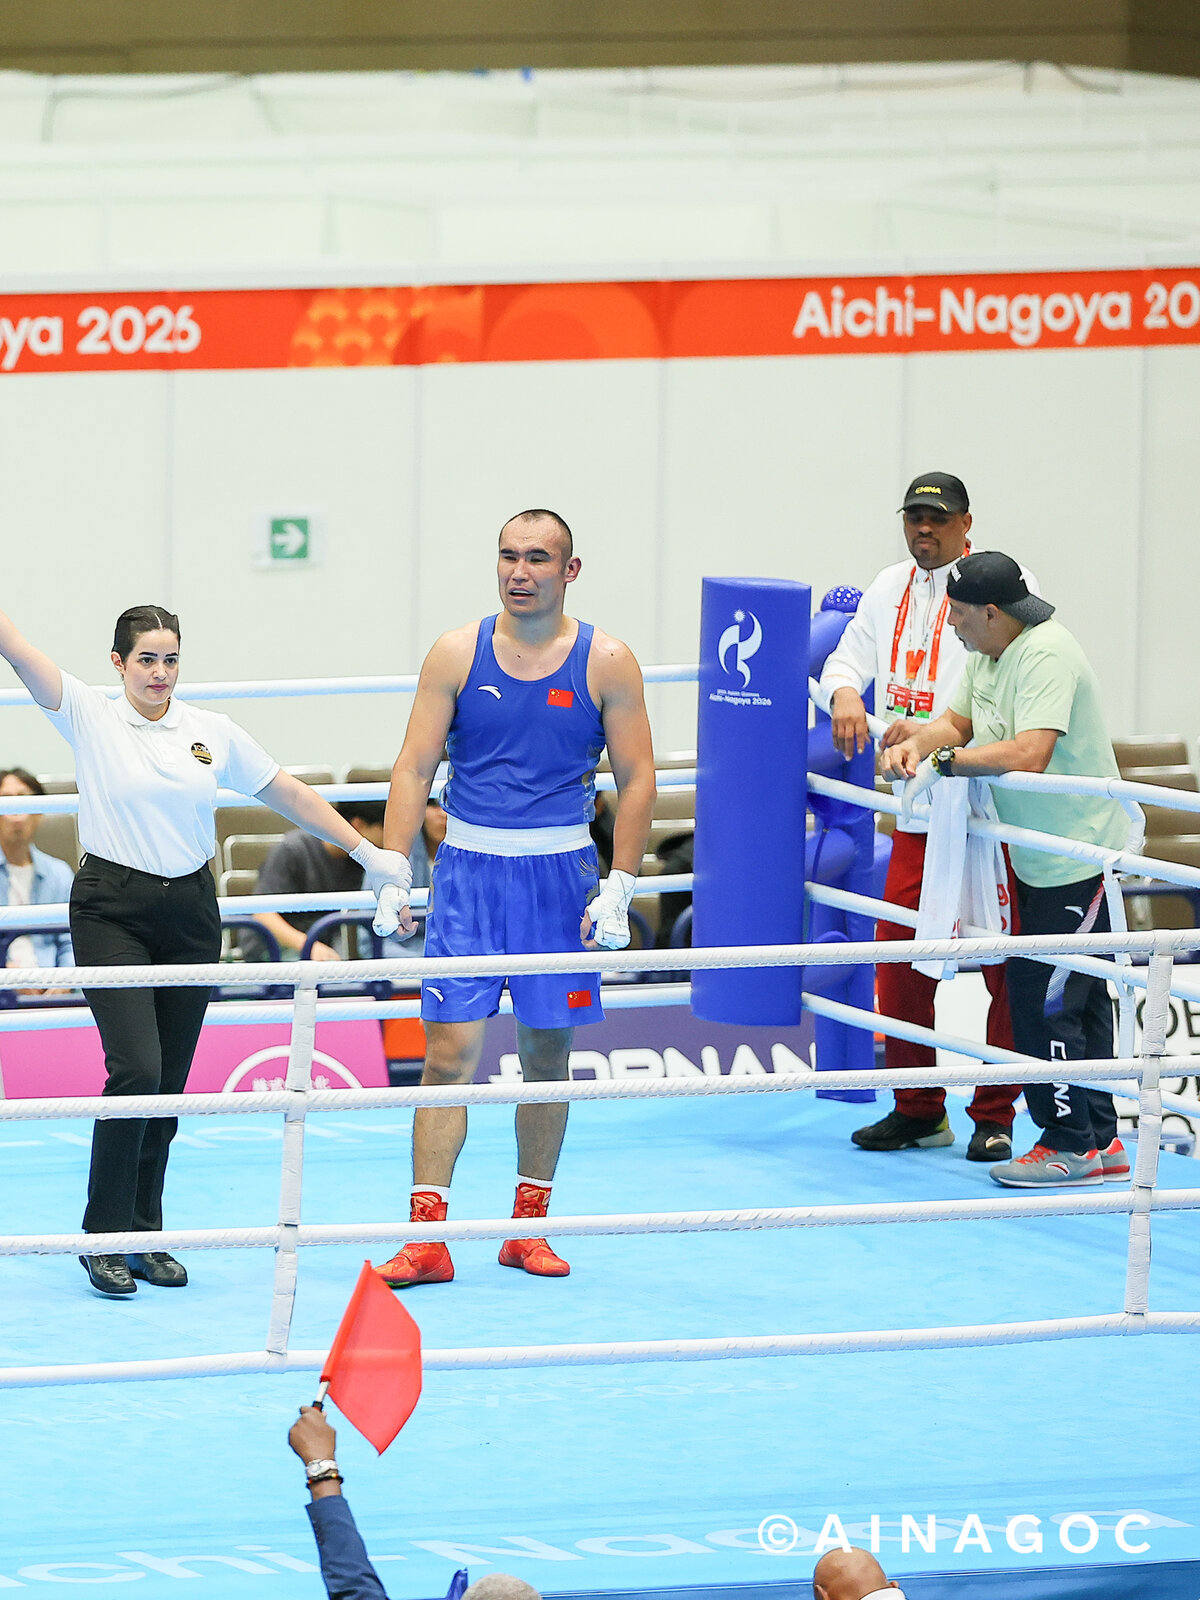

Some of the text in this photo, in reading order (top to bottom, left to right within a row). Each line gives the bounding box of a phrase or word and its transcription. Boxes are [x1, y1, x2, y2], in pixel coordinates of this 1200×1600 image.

[76, 305, 201, 355] 2026
[792, 281, 1200, 346] Aichi-Nagoya 20
[752, 697, 772, 706] 2026
[1050, 1040, 1072, 1118] CNA
